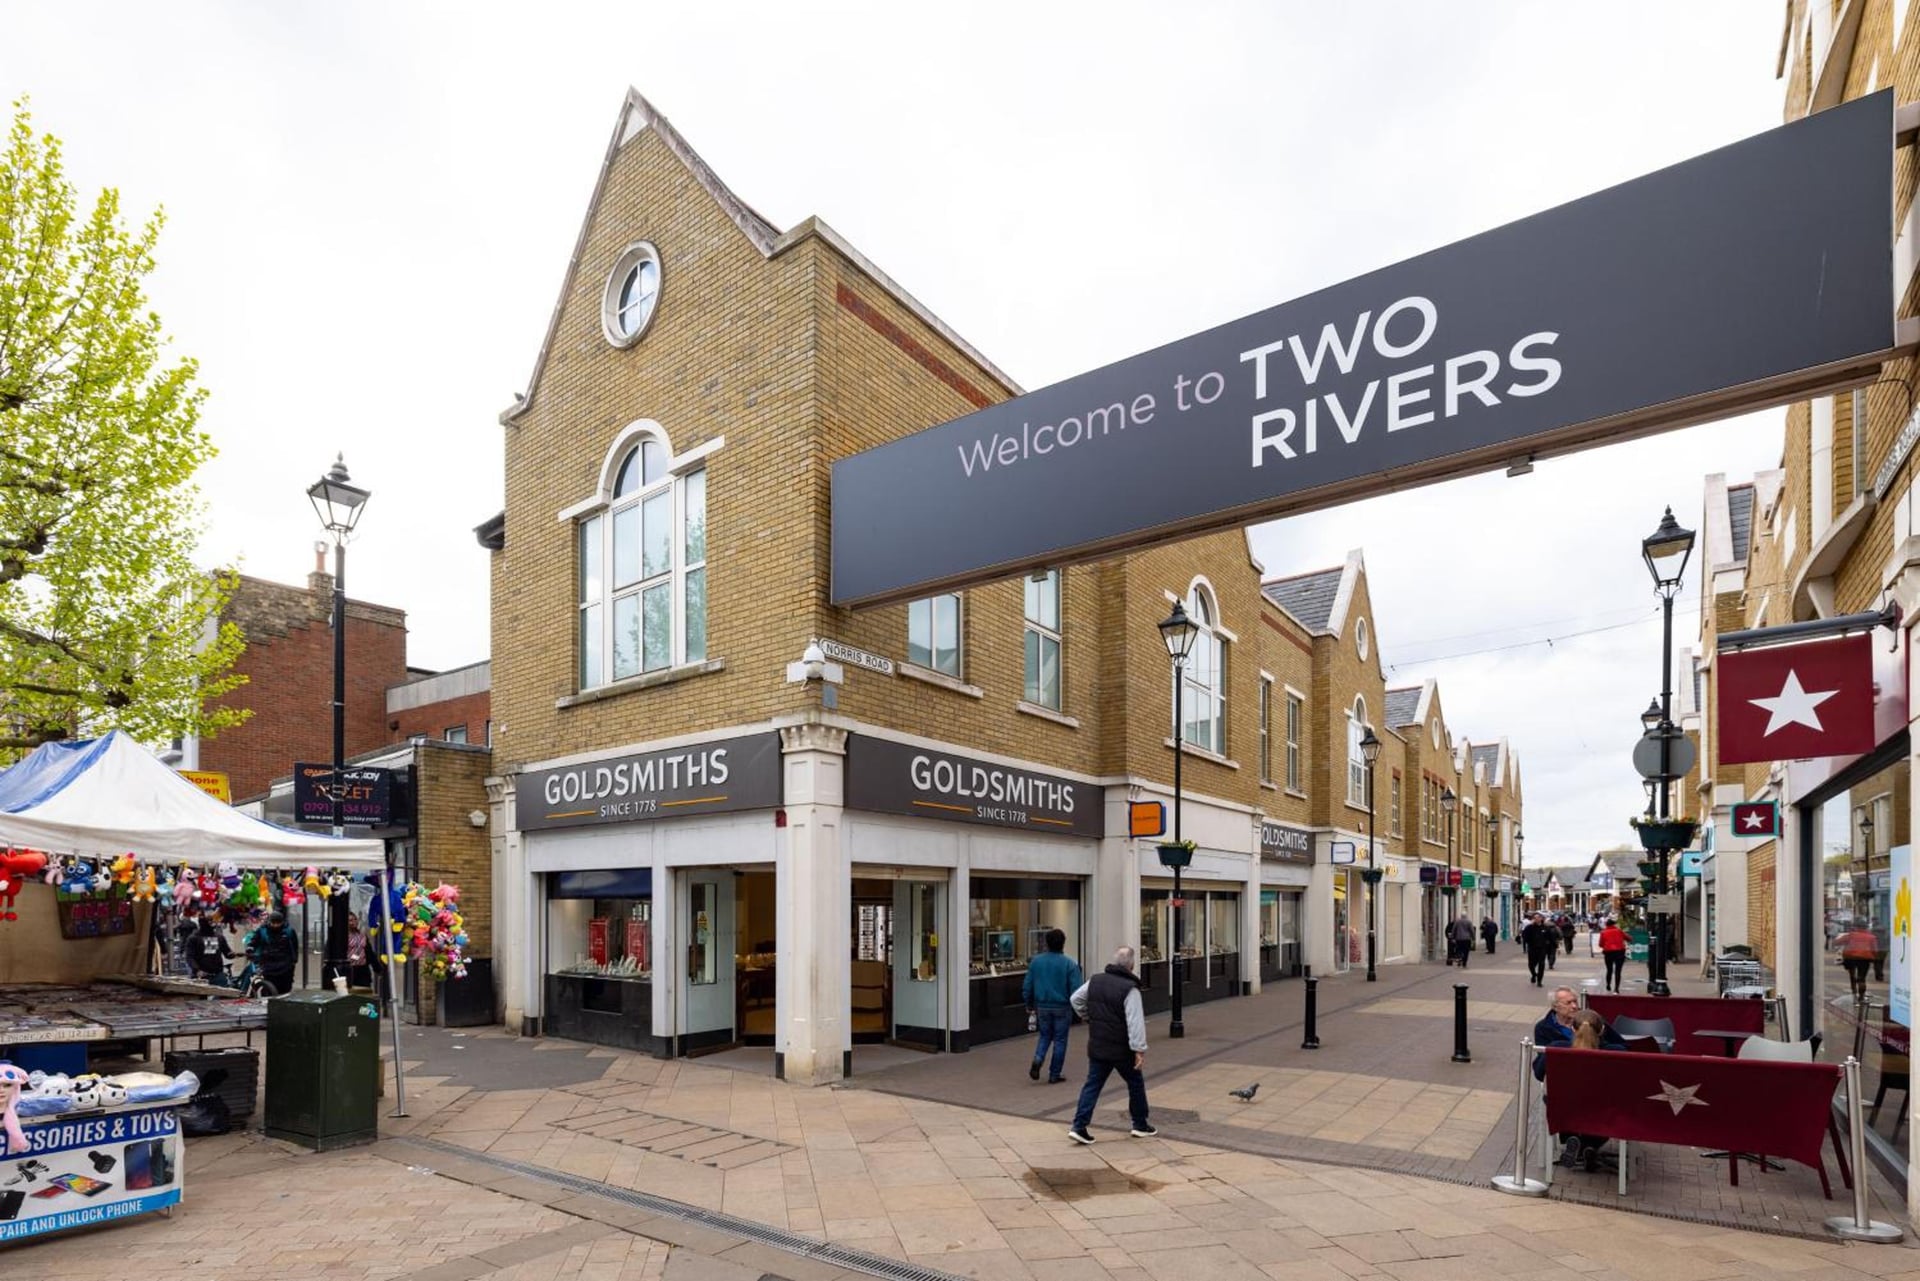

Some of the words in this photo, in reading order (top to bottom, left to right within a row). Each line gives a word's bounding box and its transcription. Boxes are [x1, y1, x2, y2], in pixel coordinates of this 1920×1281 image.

[957, 393, 1155, 478] Welcome
[1175, 369, 1225, 413] to
[1240, 296, 1438, 400] TWO
[1252, 331, 1562, 468] RIVERS
[826, 643, 862, 663] NORRIS
[865, 655, 889, 671] ROAD
[545, 748, 729, 805] GOLDSMITHS
[911, 755, 1074, 813] GOLDSMITHS
[600, 803, 630, 817] SINCE
[635, 799, 657, 814] 1778
[977, 806, 1006, 820] SINCE
[1009, 810, 1027, 824] 1778
[1262, 826, 1308, 851] OLDSMITHS
[111, 1117, 126, 1138] &
[131, 1111, 175, 1135] TOYS
[0, 1221, 28, 1237] PAIR
[31, 1217, 56, 1231] AND
[59, 1207, 105, 1227] UNLOCK
[107, 1199, 143, 1217] PHONE
